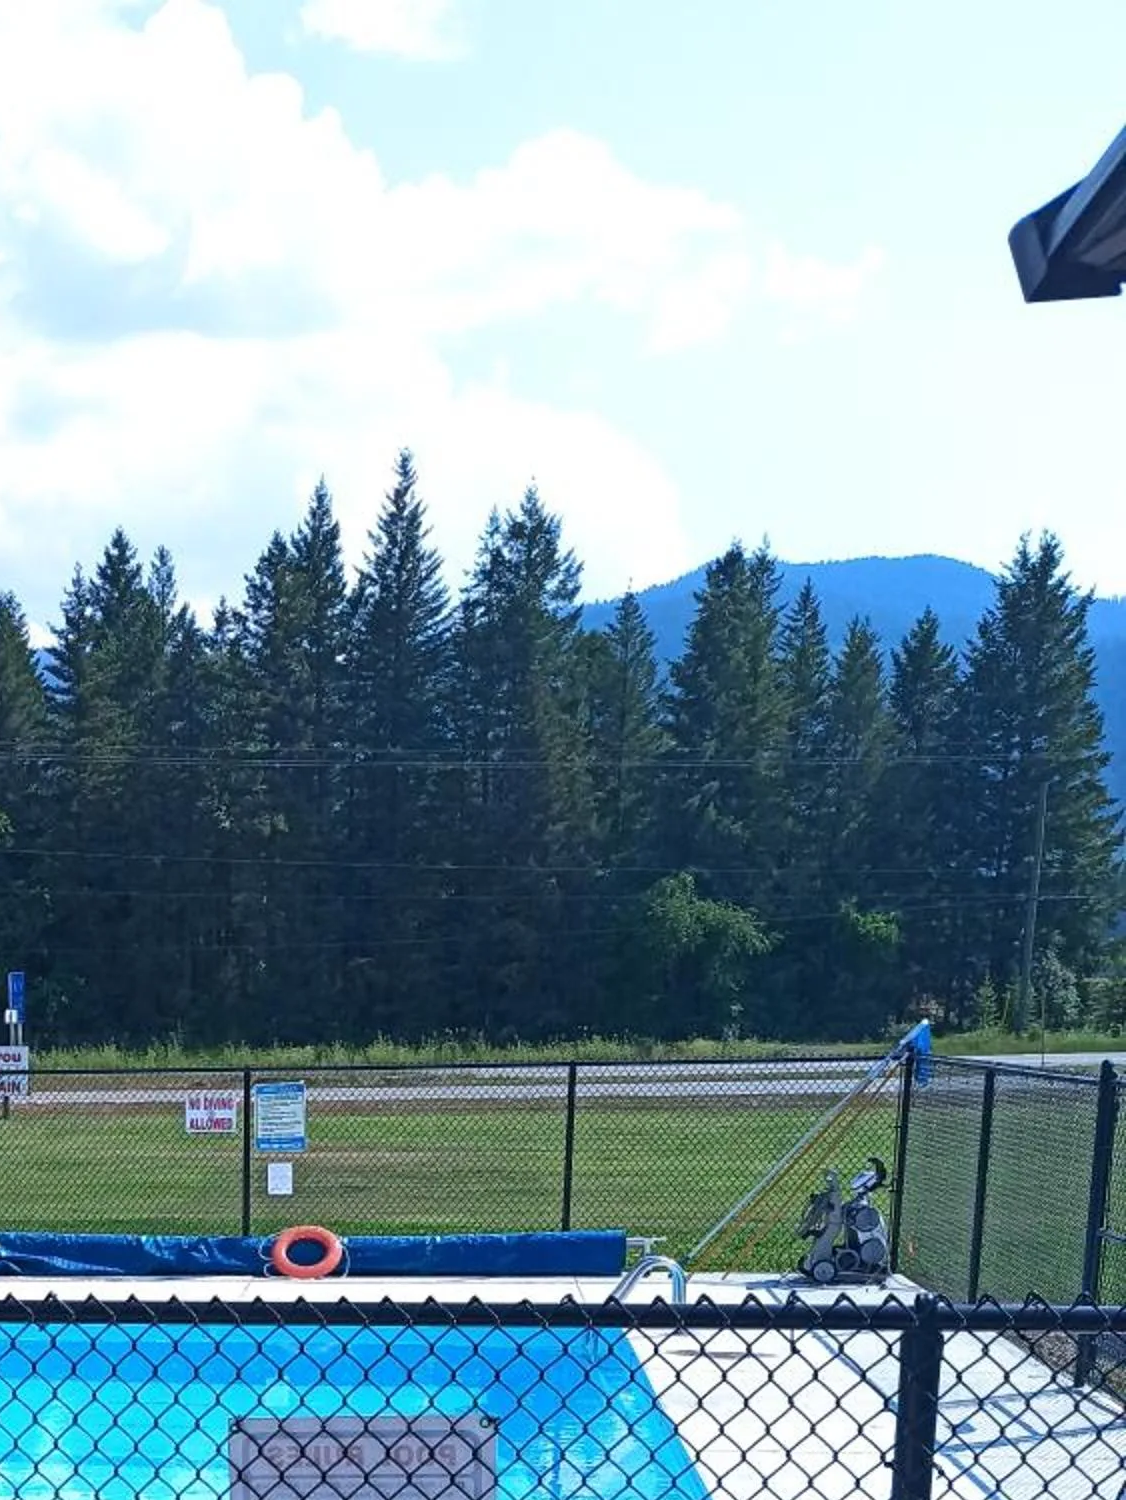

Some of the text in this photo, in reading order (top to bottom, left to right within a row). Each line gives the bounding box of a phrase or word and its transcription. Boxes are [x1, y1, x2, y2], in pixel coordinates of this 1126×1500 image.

[189, 1097, 233, 1110] NO DIVING
[189, 1117, 233, 1130] ALLOWED
